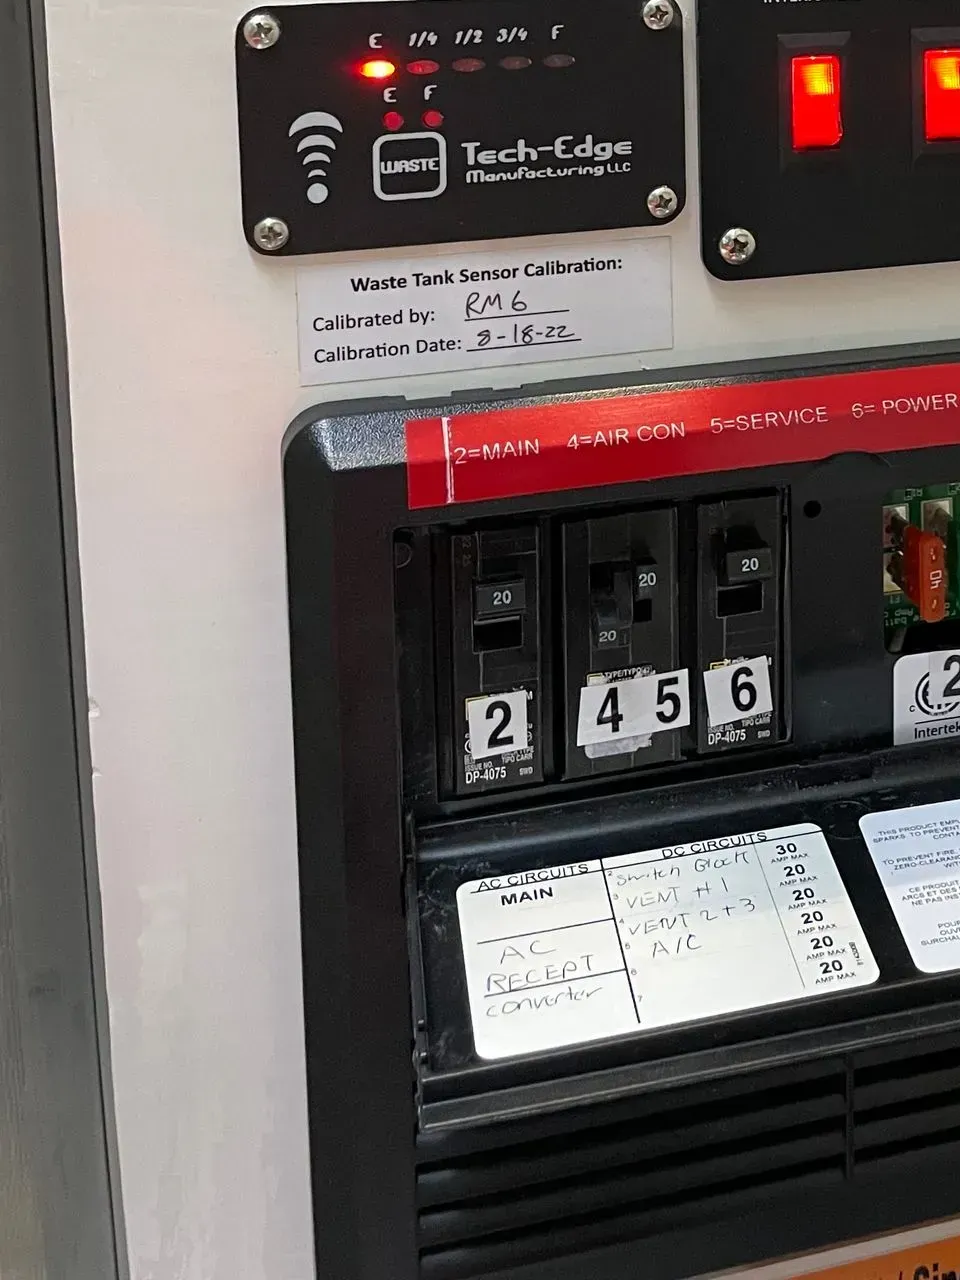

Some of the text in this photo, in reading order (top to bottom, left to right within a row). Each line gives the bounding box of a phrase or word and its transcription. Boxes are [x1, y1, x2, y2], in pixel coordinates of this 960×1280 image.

[369, 24, 564, 49] E 1/4 1/2 3/4 F
[383, 85, 437, 103] E F
[461, 135, 633, 167] Tech-Edge
[380, 157, 440, 175] WASTE
[465, 162, 631, 185] Manufacturing LLC
[351, 256, 623, 293] Waste Tank Sensor Calibration:
[312, 311, 403, 333] Calibrated
[408, 307, 435, 328] by:
[314, 341, 410, 363] Calibration
[416, 336, 462, 355] Date:
[454, 438, 540, 465] 2=MAIN
[566, 429, 629, 451] 4=AIR
[636, 421, 686, 442] CON
[710, 406, 828, 434] 5=SERVICE
[882, 393, 958, 415] POWER
[742, 557, 760, 572] 20
[638, 572, 657, 587] 20
[493, 590, 512, 606] 20
[599, 630, 617, 642] 20
[731, 666, 757, 712] 6
[596, 677, 681, 733] 4 5
[485, 700, 514, 749] 2
[707, 729, 747, 746] DP-4075
[465, 766, 506, 784] DP-4075
[662, 832, 768, 859] DC CIRCUITS
[776, 842, 797, 856] 30
[478, 863, 589, 892] AC CIRCUITS
[784, 863, 806, 877] 20
[500, 886, 554, 906] MAIN
[626, 886, 680, 910] VENT
[793, 887, 815, 901] 20
[628, 913, 690, 936] VENT
[743, 898, 756, 913] 3
[801, 910, 824, 925] 20
[811, 935, 834, 950] 20
[820, 959, 843, 974] 20
